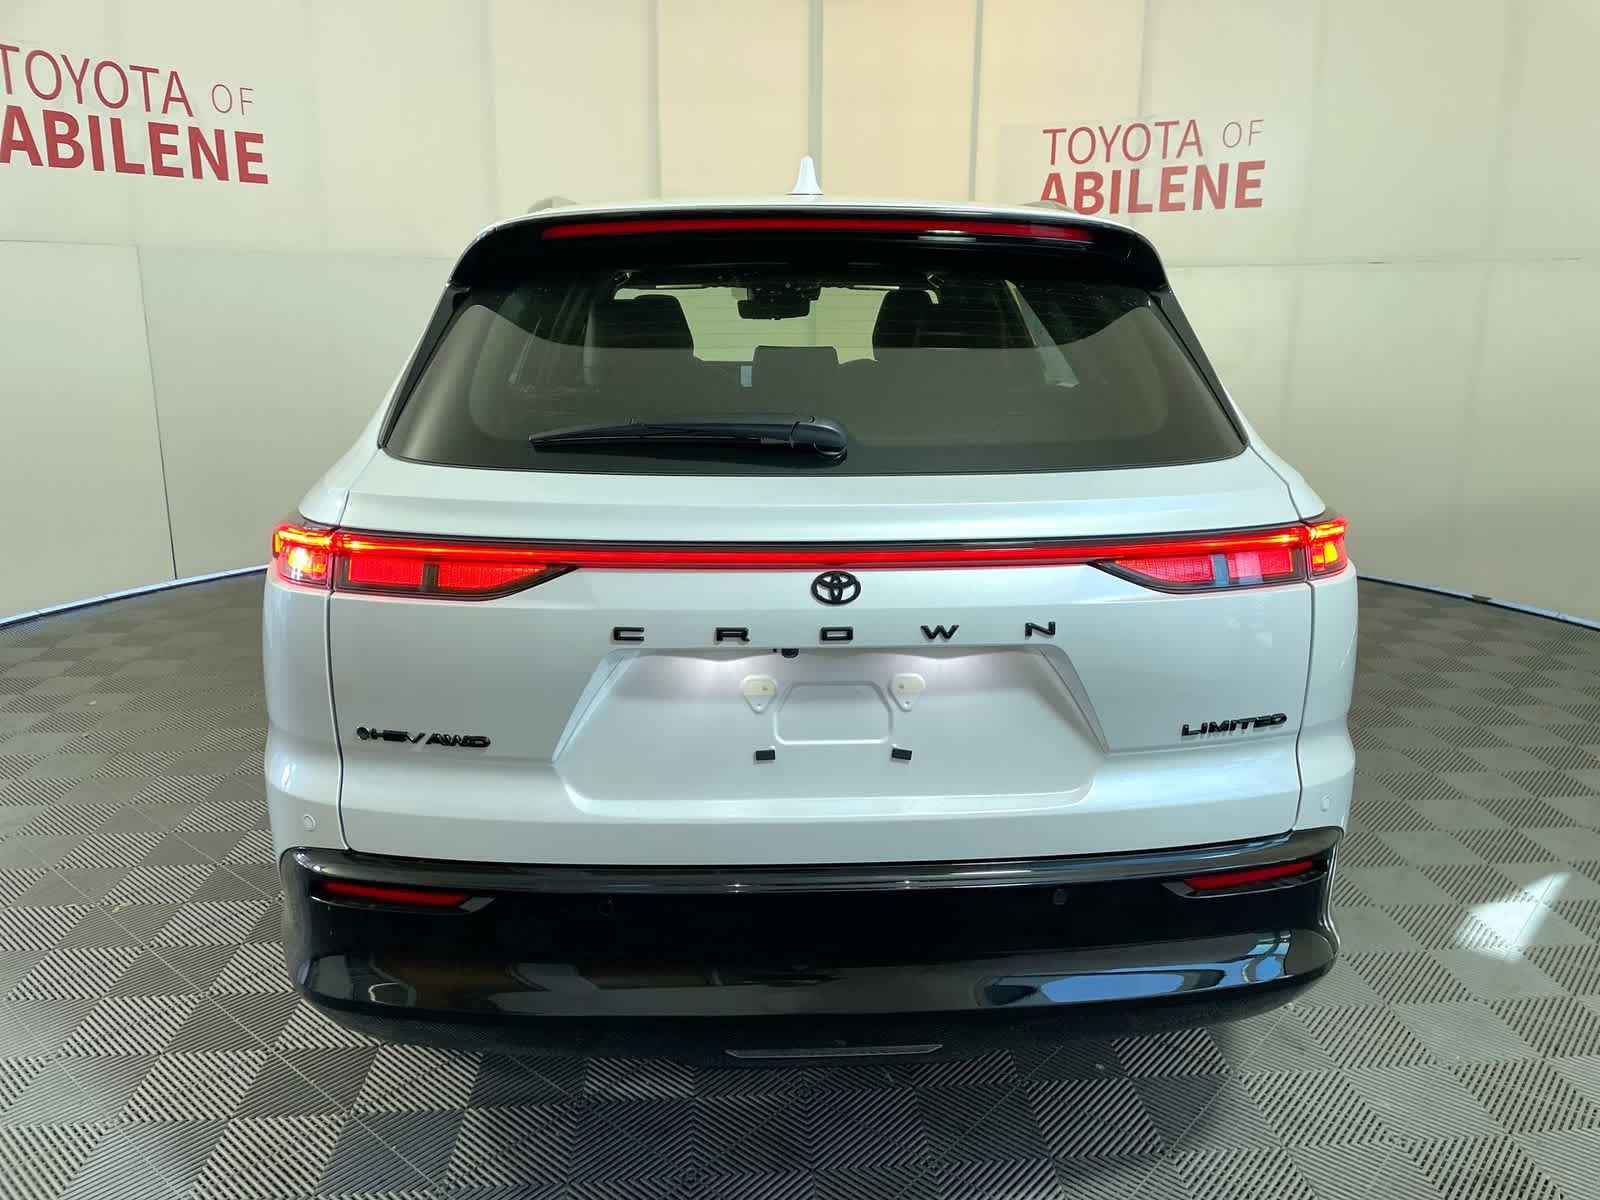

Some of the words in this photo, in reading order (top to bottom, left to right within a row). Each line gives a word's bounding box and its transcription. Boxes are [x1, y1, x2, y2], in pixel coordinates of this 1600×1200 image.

[0, 43, 194, 117] TOYOTA
[211, 83, 254, 116] OF
[0, 104, 268, 185] ABILENE
[1042, 119, 1203, 166] TOYOTA
[1222, 119, 1264, 148] OF
[1040, 160, 1266, 216] ABILENE
[612, 621, 1056, 644] CROWN
[1181, 712, 1288, 737] LIMITED
